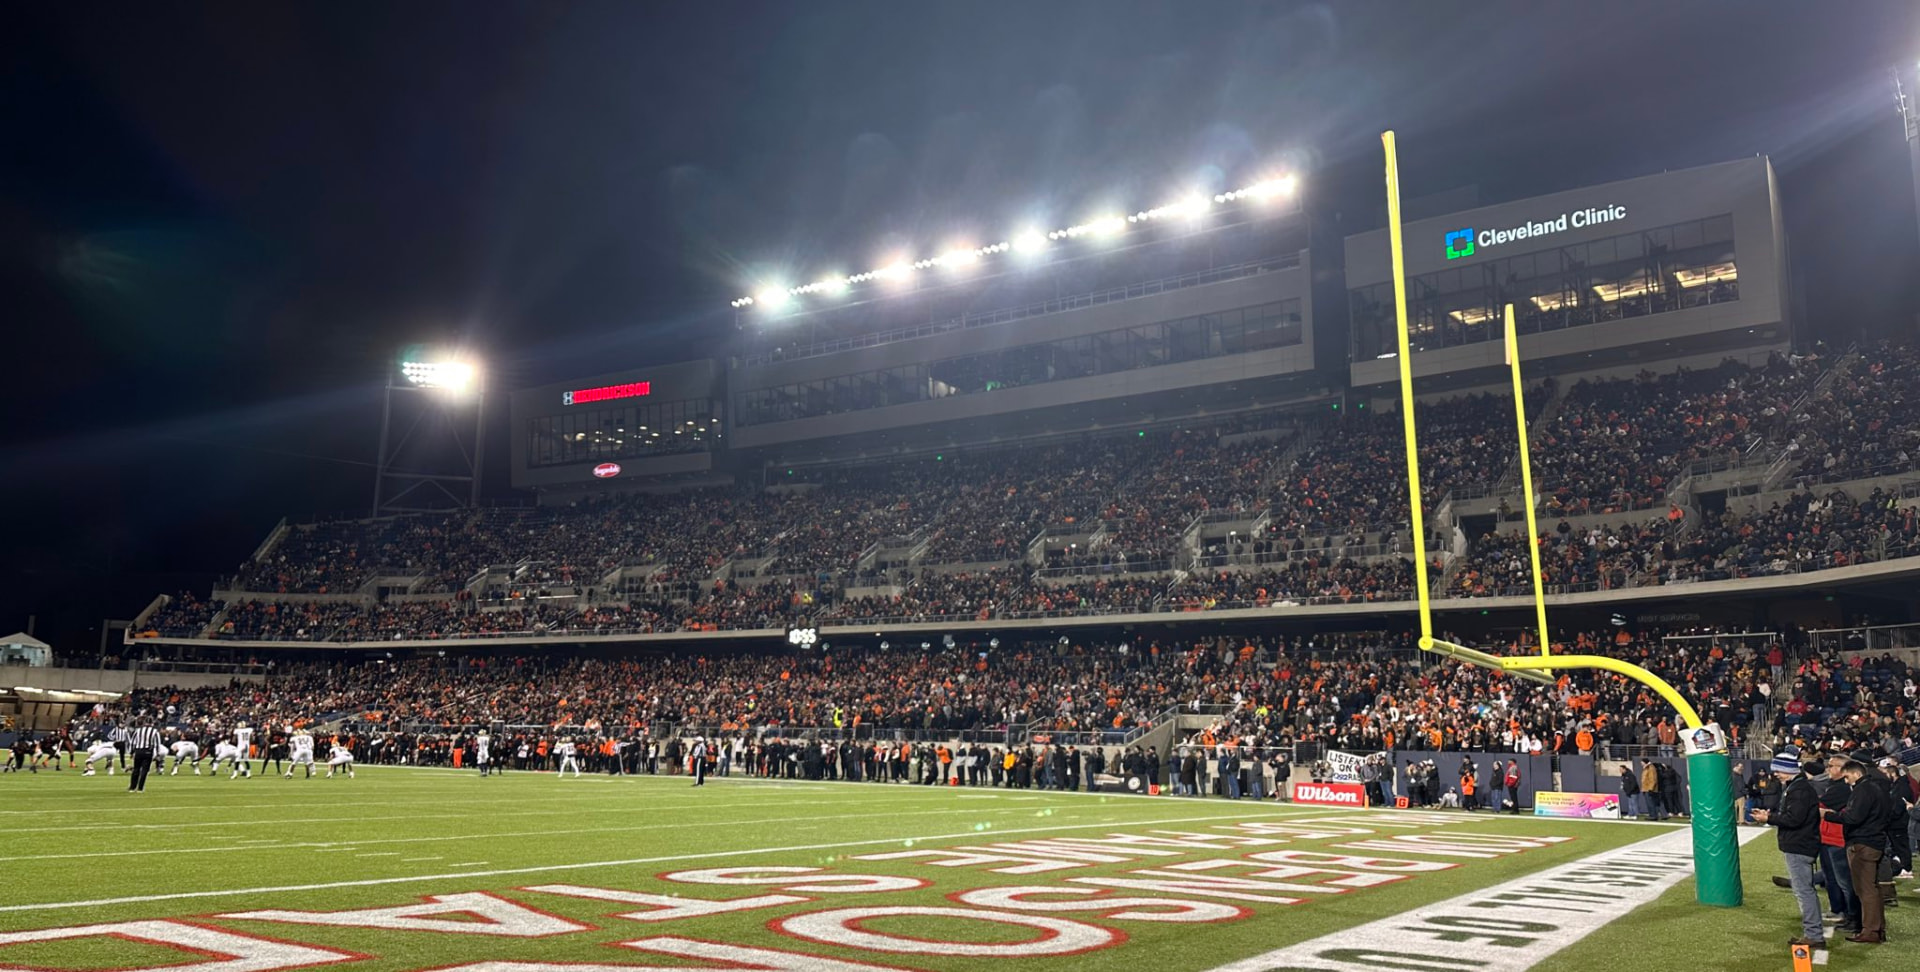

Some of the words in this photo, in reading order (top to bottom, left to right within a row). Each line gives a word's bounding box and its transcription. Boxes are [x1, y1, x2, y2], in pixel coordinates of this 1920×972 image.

[1477, 213, 1567, 248] Cleveland
[1571, 204, 1627, 228] Clinic
[1297, 786, 1359, 803] Wilson
[847, 831, 1295, 875] FAME
[1329, 831, 1576, 859] TOM
[1549, 858, 1689, 888] TAKES
[1468, 885, 1626, 913] ALL
[1399, 915, 1559, 948] OF
[1261, 948, 1491, 972] U
